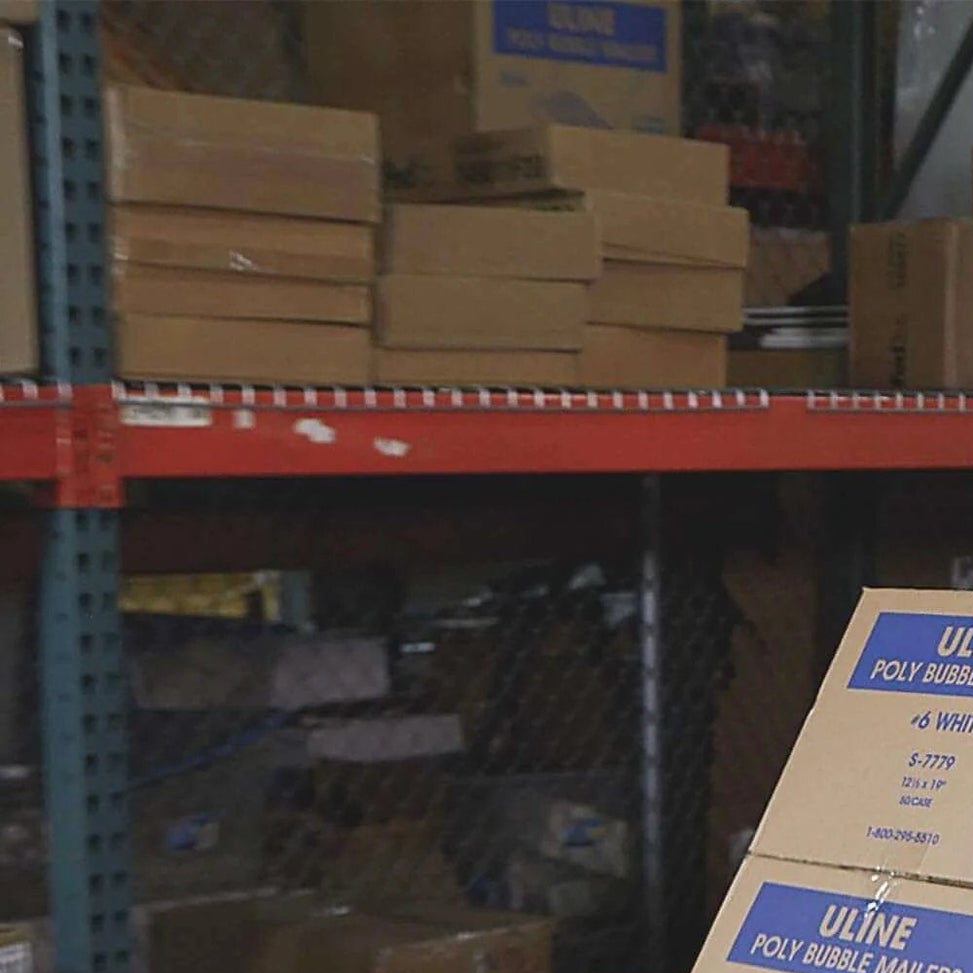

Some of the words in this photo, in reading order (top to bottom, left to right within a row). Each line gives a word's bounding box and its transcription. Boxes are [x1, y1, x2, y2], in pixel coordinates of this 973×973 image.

[870, 659, 922, 682] POLY
[908, 753, 956, 770] S-7779
[819, 904, 917, 950] ULINE
[750, 933, 803, 962] POLY
